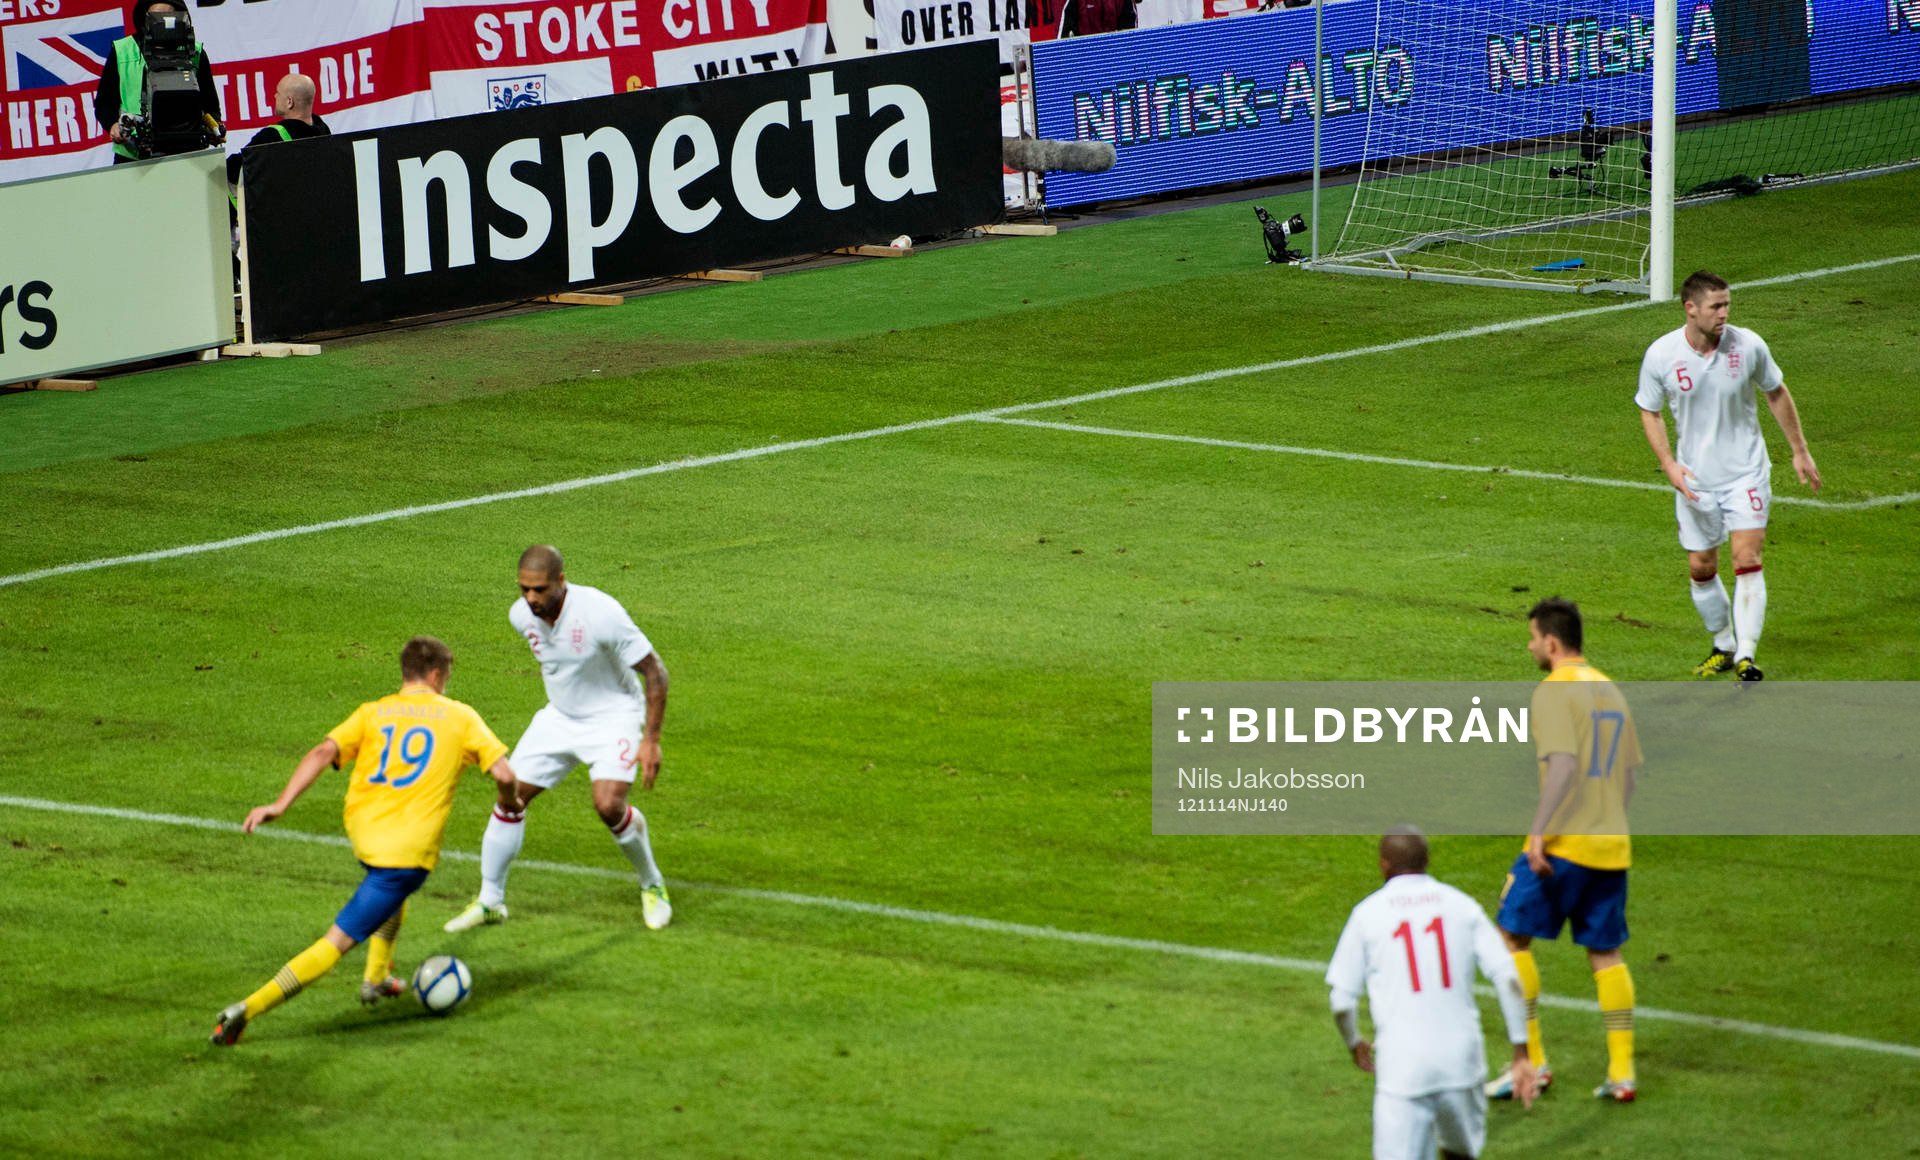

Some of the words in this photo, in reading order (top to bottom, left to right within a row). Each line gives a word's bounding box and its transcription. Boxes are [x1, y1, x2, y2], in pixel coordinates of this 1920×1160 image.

[474, 0, 641, 61] STOKE
[901, 1, 974, 46] OVER
[319, 47, 375, 104] DIE
[1075, 47, 1414, 142] Nilfisk-ALTO
[352, 70, 939, 283] Inspecta
[1675, 367, 1693, 392] 5
[1747, 487, 1763, 512] 5
[368, 724, 434, 788] 19
[618, 738, 632, 769] 2
[1586, 709, 1625, 779] 17
[1393, 915, 1452, 992] 11
